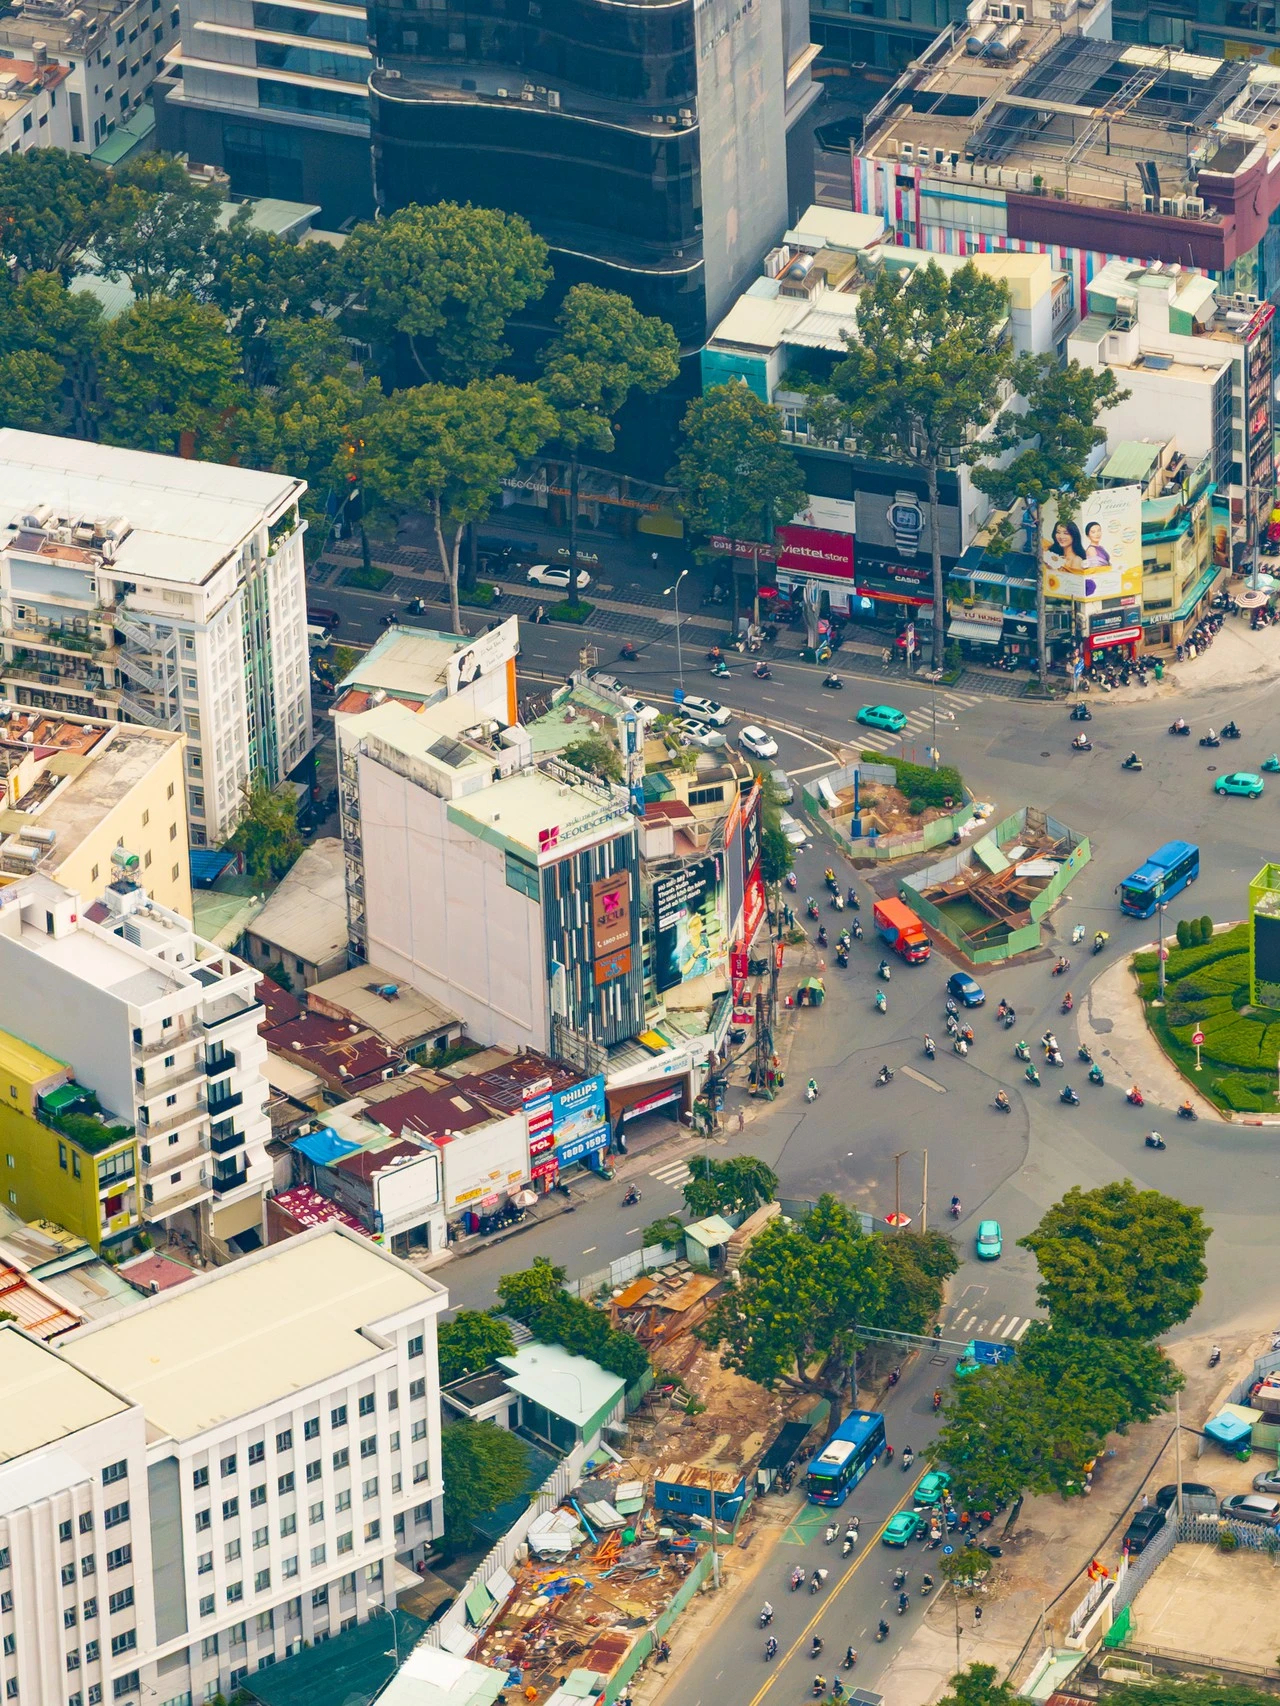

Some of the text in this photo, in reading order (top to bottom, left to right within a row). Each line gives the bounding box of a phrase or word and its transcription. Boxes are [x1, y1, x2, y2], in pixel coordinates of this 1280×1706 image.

[557, 548, 599, 561] CAELLA
[894, 575, 920, 585] CASIO
[560, 822, 592, 842] SEOUL
[592, 805, 630, 828] CENTER
[560, 1081, 598, 1106] PHILIPS
[530, 1139, 551, 1153] TCL
[562, 1143, 585, 1160] 1800
